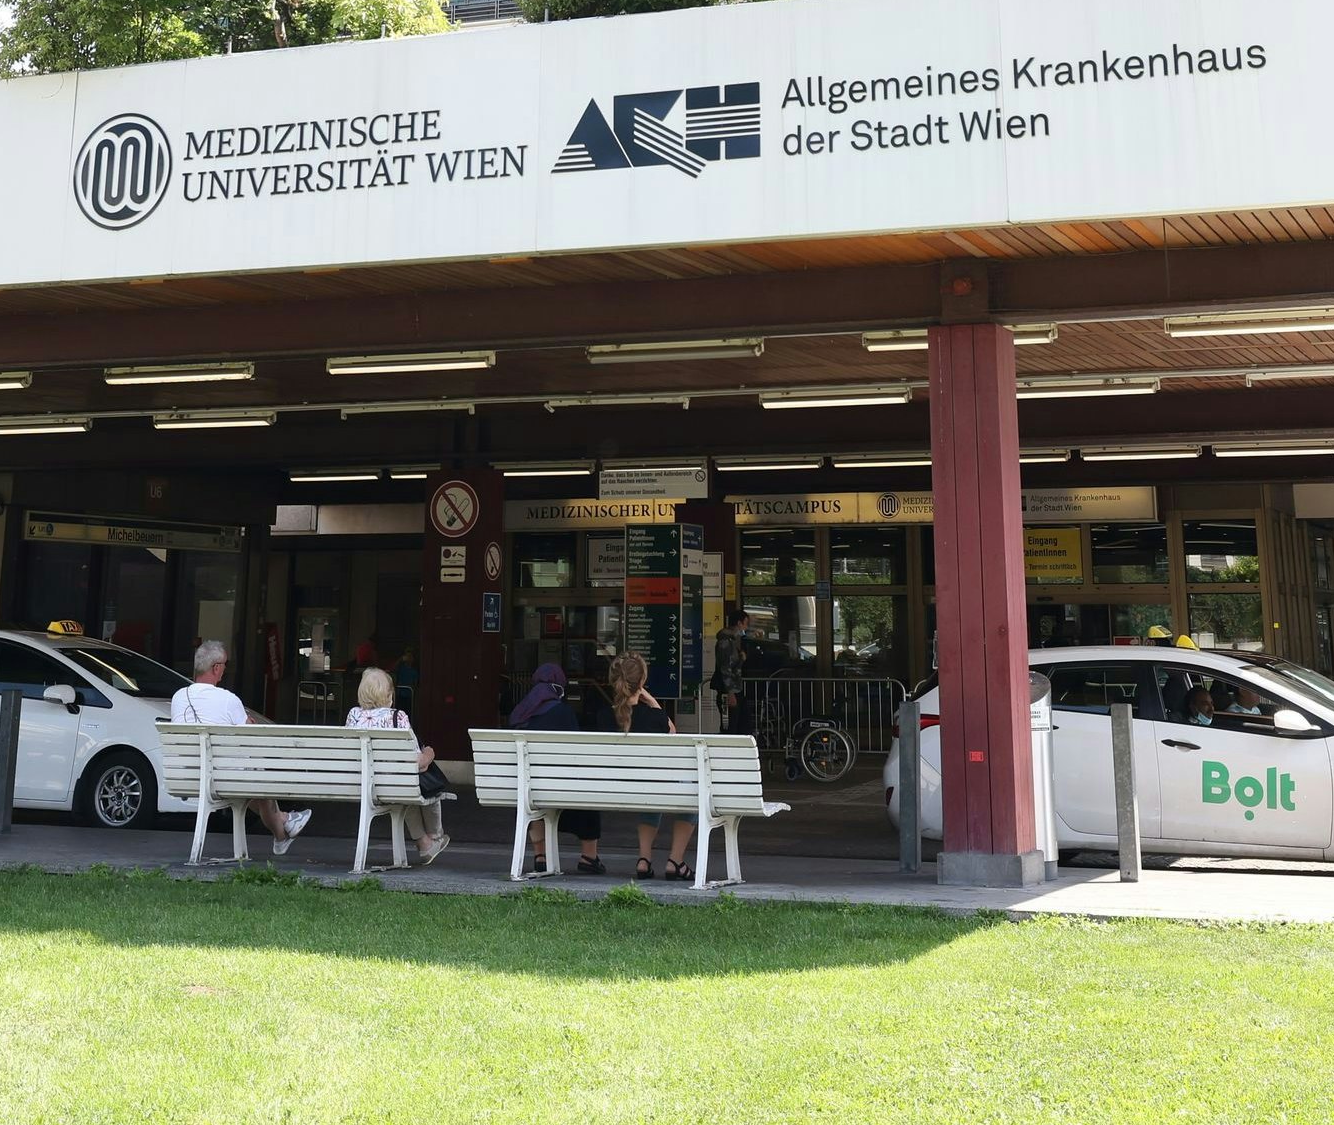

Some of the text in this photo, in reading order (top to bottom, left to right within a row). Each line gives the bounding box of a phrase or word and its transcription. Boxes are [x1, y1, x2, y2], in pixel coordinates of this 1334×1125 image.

[780, 43, 1267, 115] Allgemeines Krankenhaus
[183, 110, 441, 161] MEDIZINISCHE
[782, 107, 1051, 157] der Stadt Wien
[182, 145, 528, 202] UNIVERSITÄT WIEN
[1030, 493, 1121, 504] Allgemeines Krankenhaus
[526, 504, 652, 520] MEDIZINISCHER
[1031, 503, 1083, 512] der Stadt Wien
[107, 527, 164, 544] Michelbeuern
[1028, 536, 1058, 547] Eingang
[1025, 548, 1067, 557] atientInnen
[1202, 760, 1296, 821] Bolt
